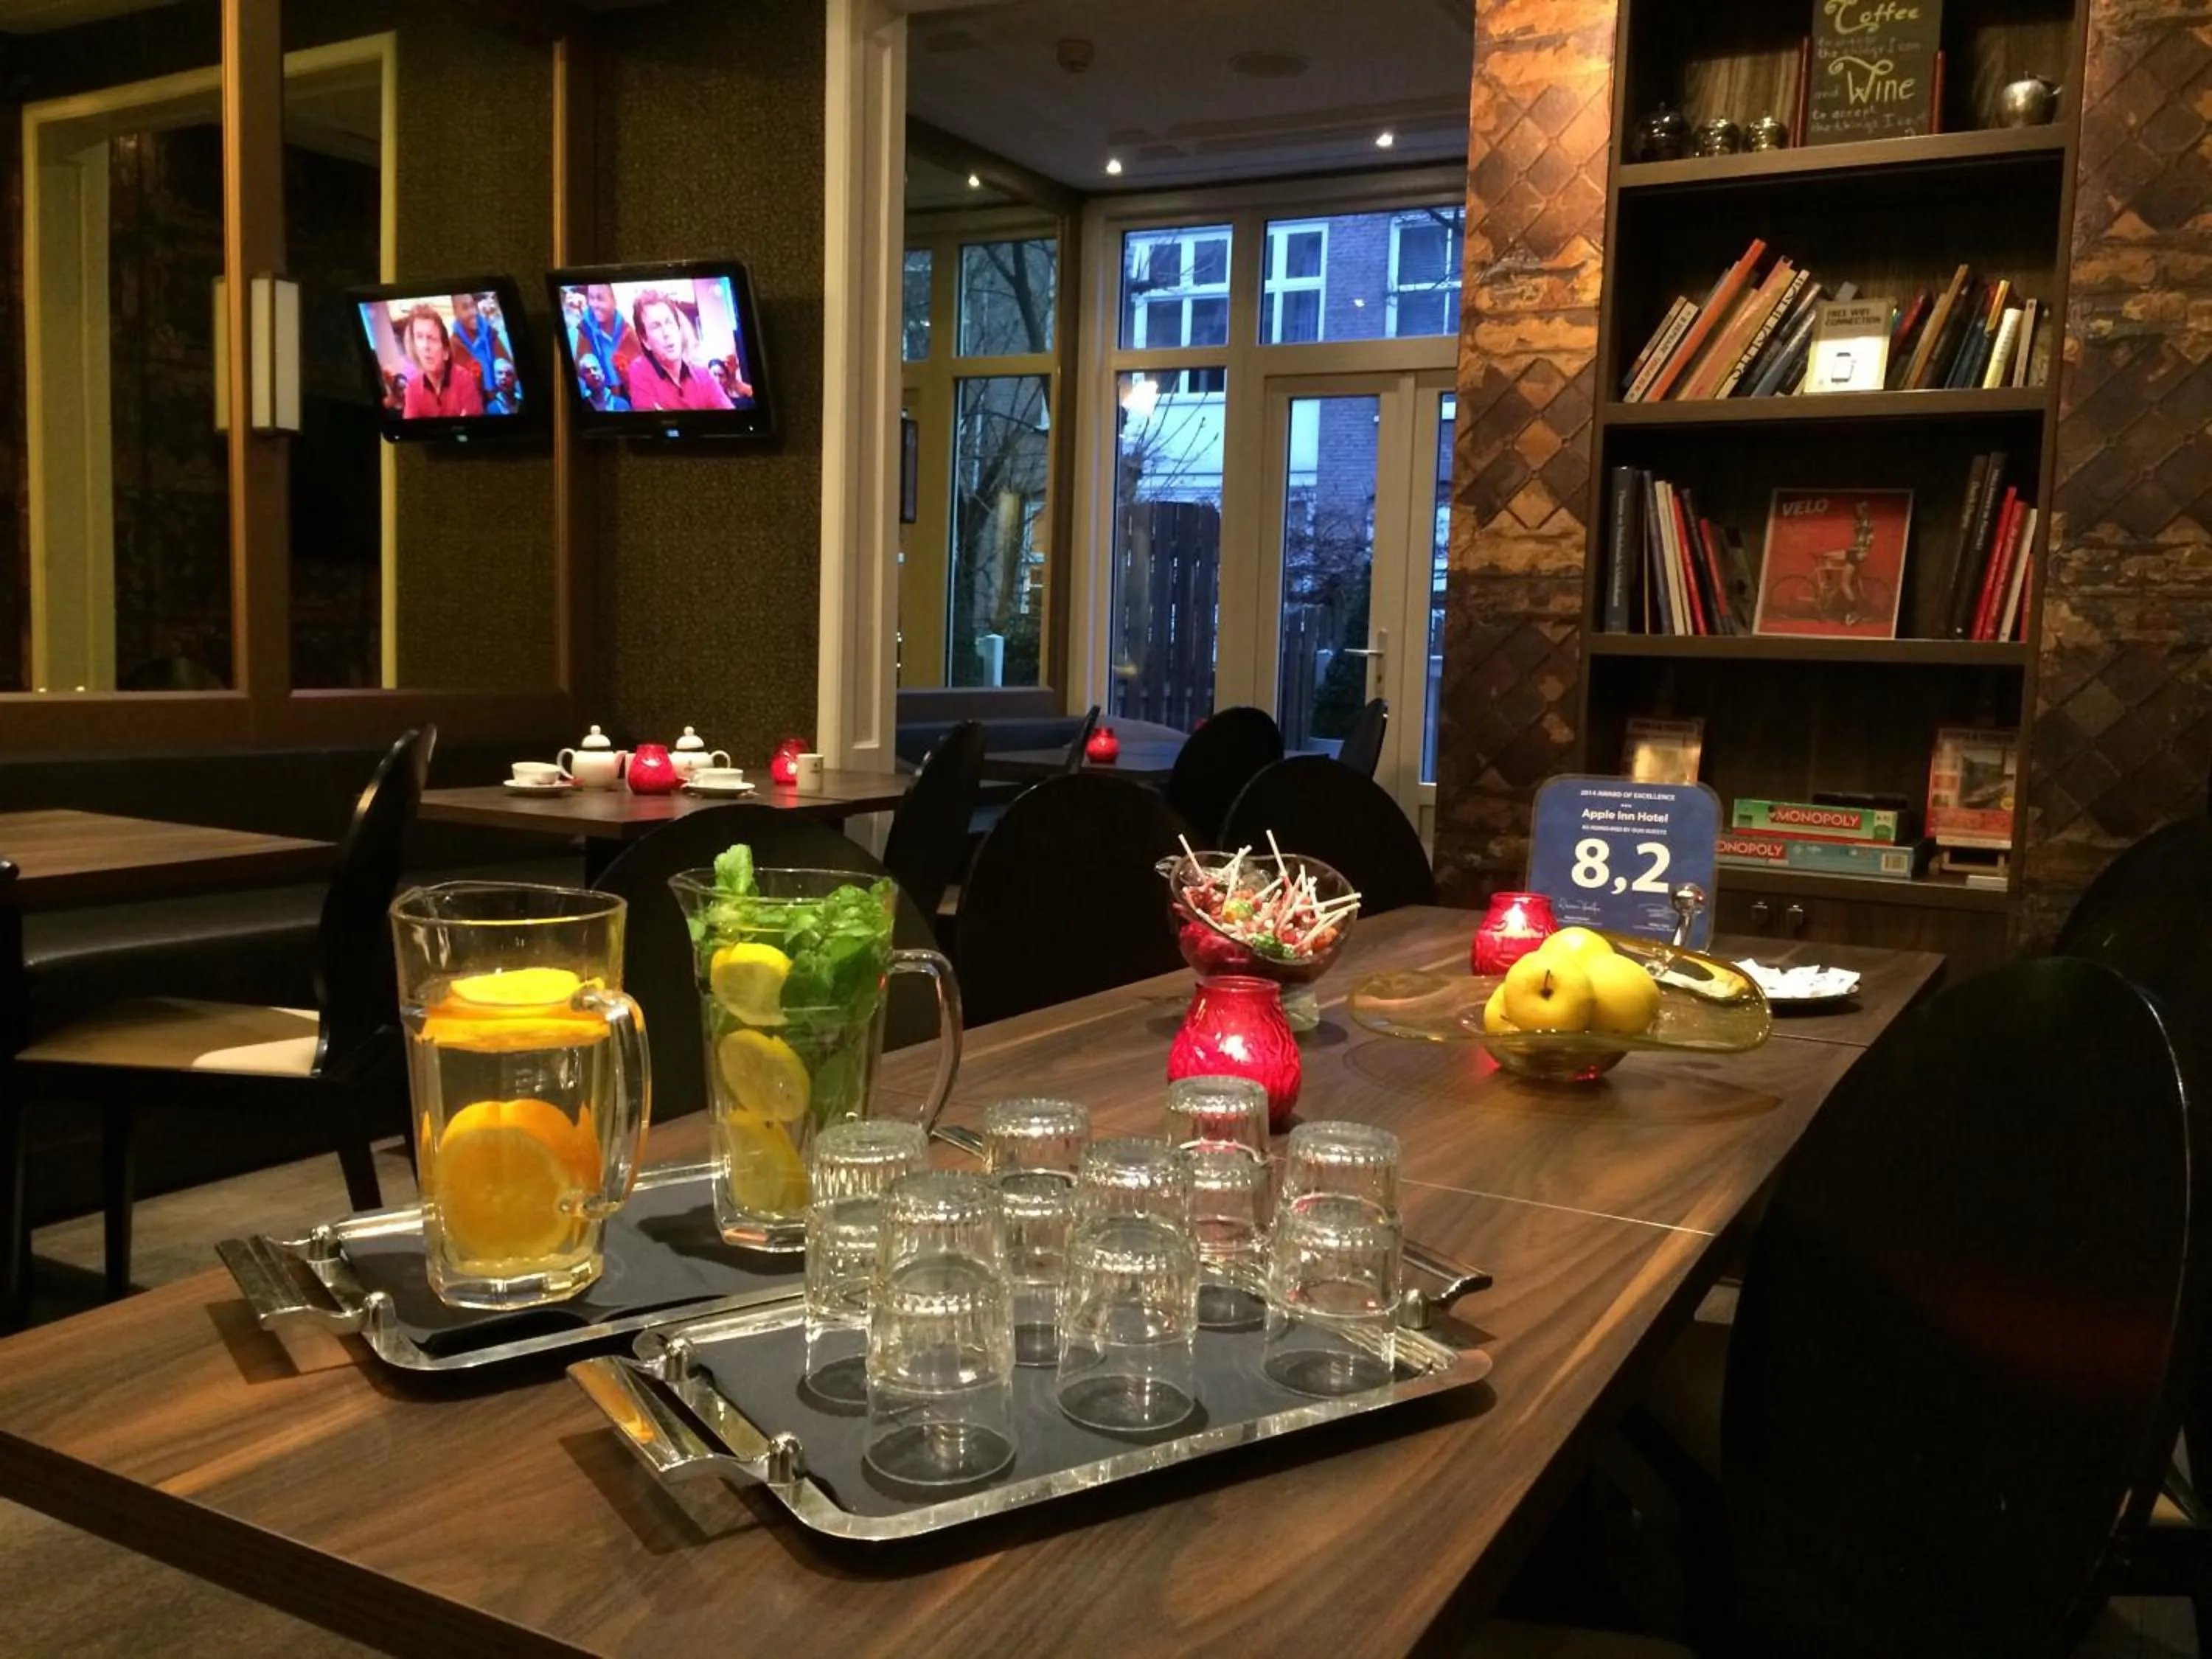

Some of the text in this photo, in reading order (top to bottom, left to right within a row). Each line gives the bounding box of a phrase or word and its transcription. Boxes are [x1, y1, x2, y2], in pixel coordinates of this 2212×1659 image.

[1824, 0, 1921, 33] Coffee
[1828, 55, 1916, 105] Wine
[1825, 316, 1881, 327] CONNECTION
[1783, 498, 1829, 517] VELO
[1597, 790, 1622, 798] AWARD
[1633, 792, 1676, 801] EXCELLENCE
[1582, 808, 1669, 823] Apple Inn Hotel
[1776, 809, 1860, 827] MONOPOLY
[1715, 840, 1784, 858] ONOPOLY
[1571, 838, 1671, 895] 8,2
